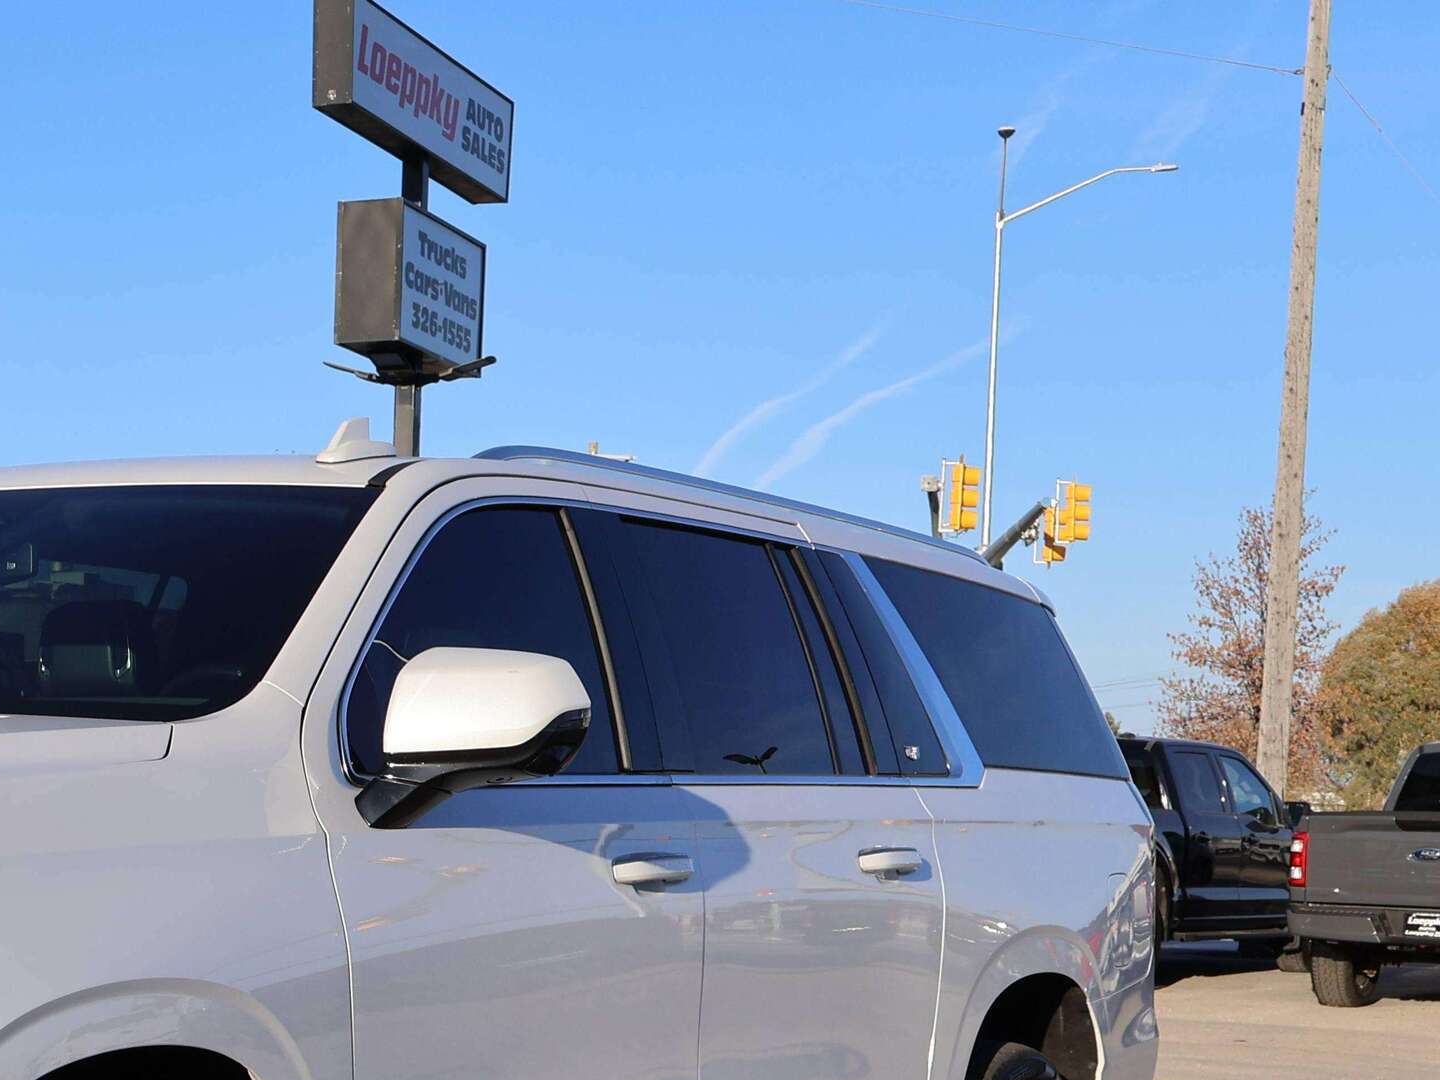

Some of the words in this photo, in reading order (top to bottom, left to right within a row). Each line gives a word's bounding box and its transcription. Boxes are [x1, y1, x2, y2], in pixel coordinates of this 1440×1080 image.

[357, 24, 461, 141] Loeppky
[465, 97, 504, 143] AUTO
[461, 126, 506, 176] SALES
[418, 229, 467, 280] Trucks
